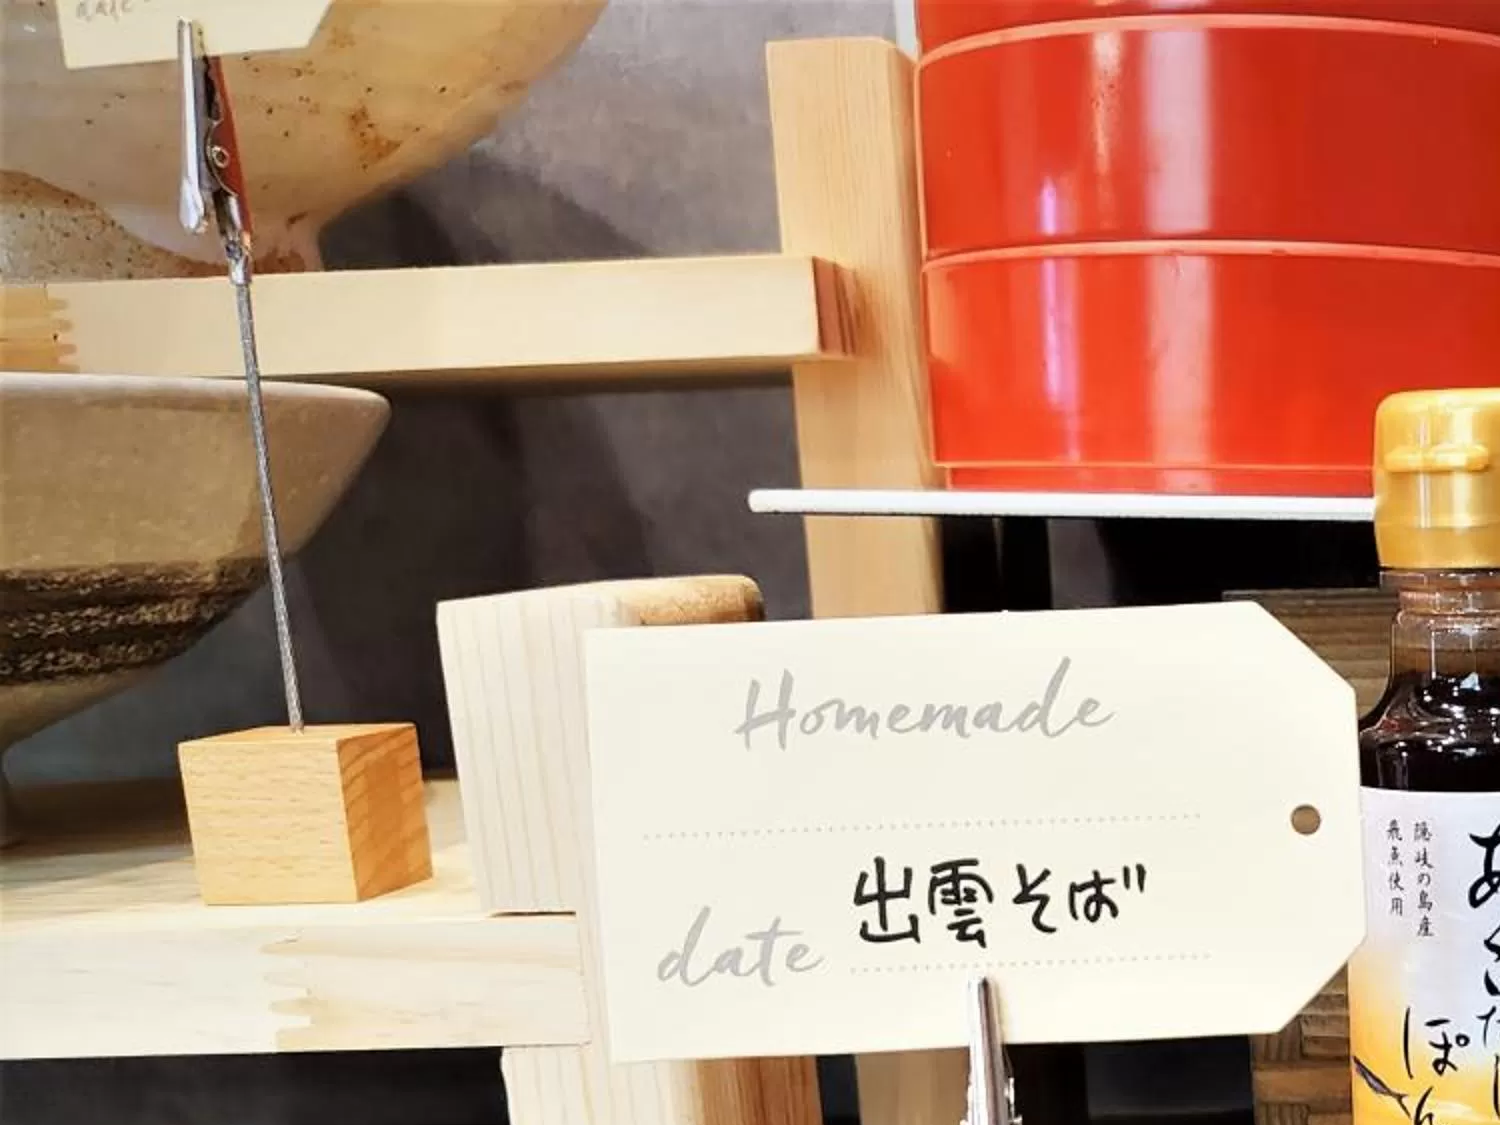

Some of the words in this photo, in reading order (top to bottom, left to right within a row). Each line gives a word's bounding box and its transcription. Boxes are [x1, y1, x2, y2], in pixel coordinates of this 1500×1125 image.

[735, 656, 1116, 751] Homemade
[656, 906, 824, 987] date
[853, 856, 1147, 948] 出雲そば
